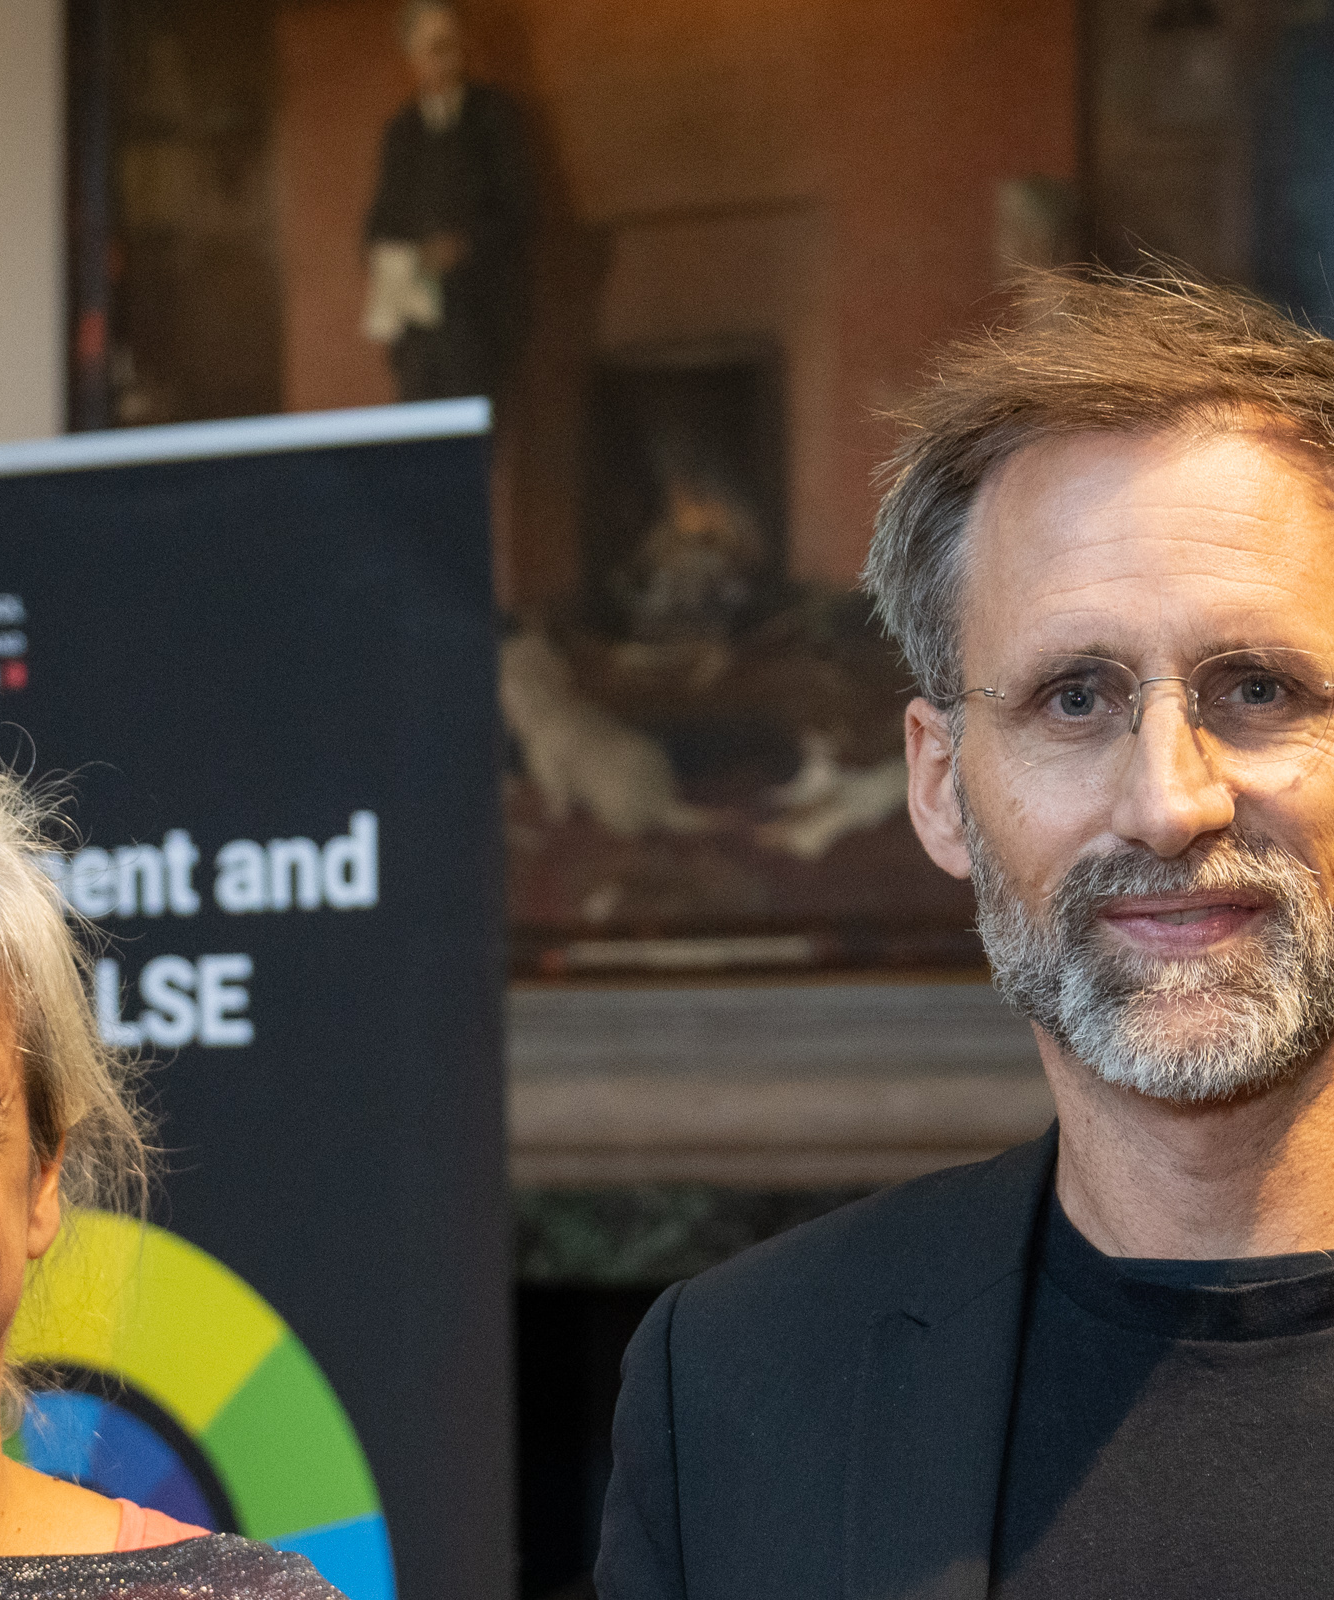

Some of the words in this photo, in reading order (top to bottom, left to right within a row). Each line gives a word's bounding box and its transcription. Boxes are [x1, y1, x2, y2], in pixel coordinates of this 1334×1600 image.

[45, 828, 200, 917] ent
[215, 809, 379, 916] and
[94, 953, 255, 1048] LSE
